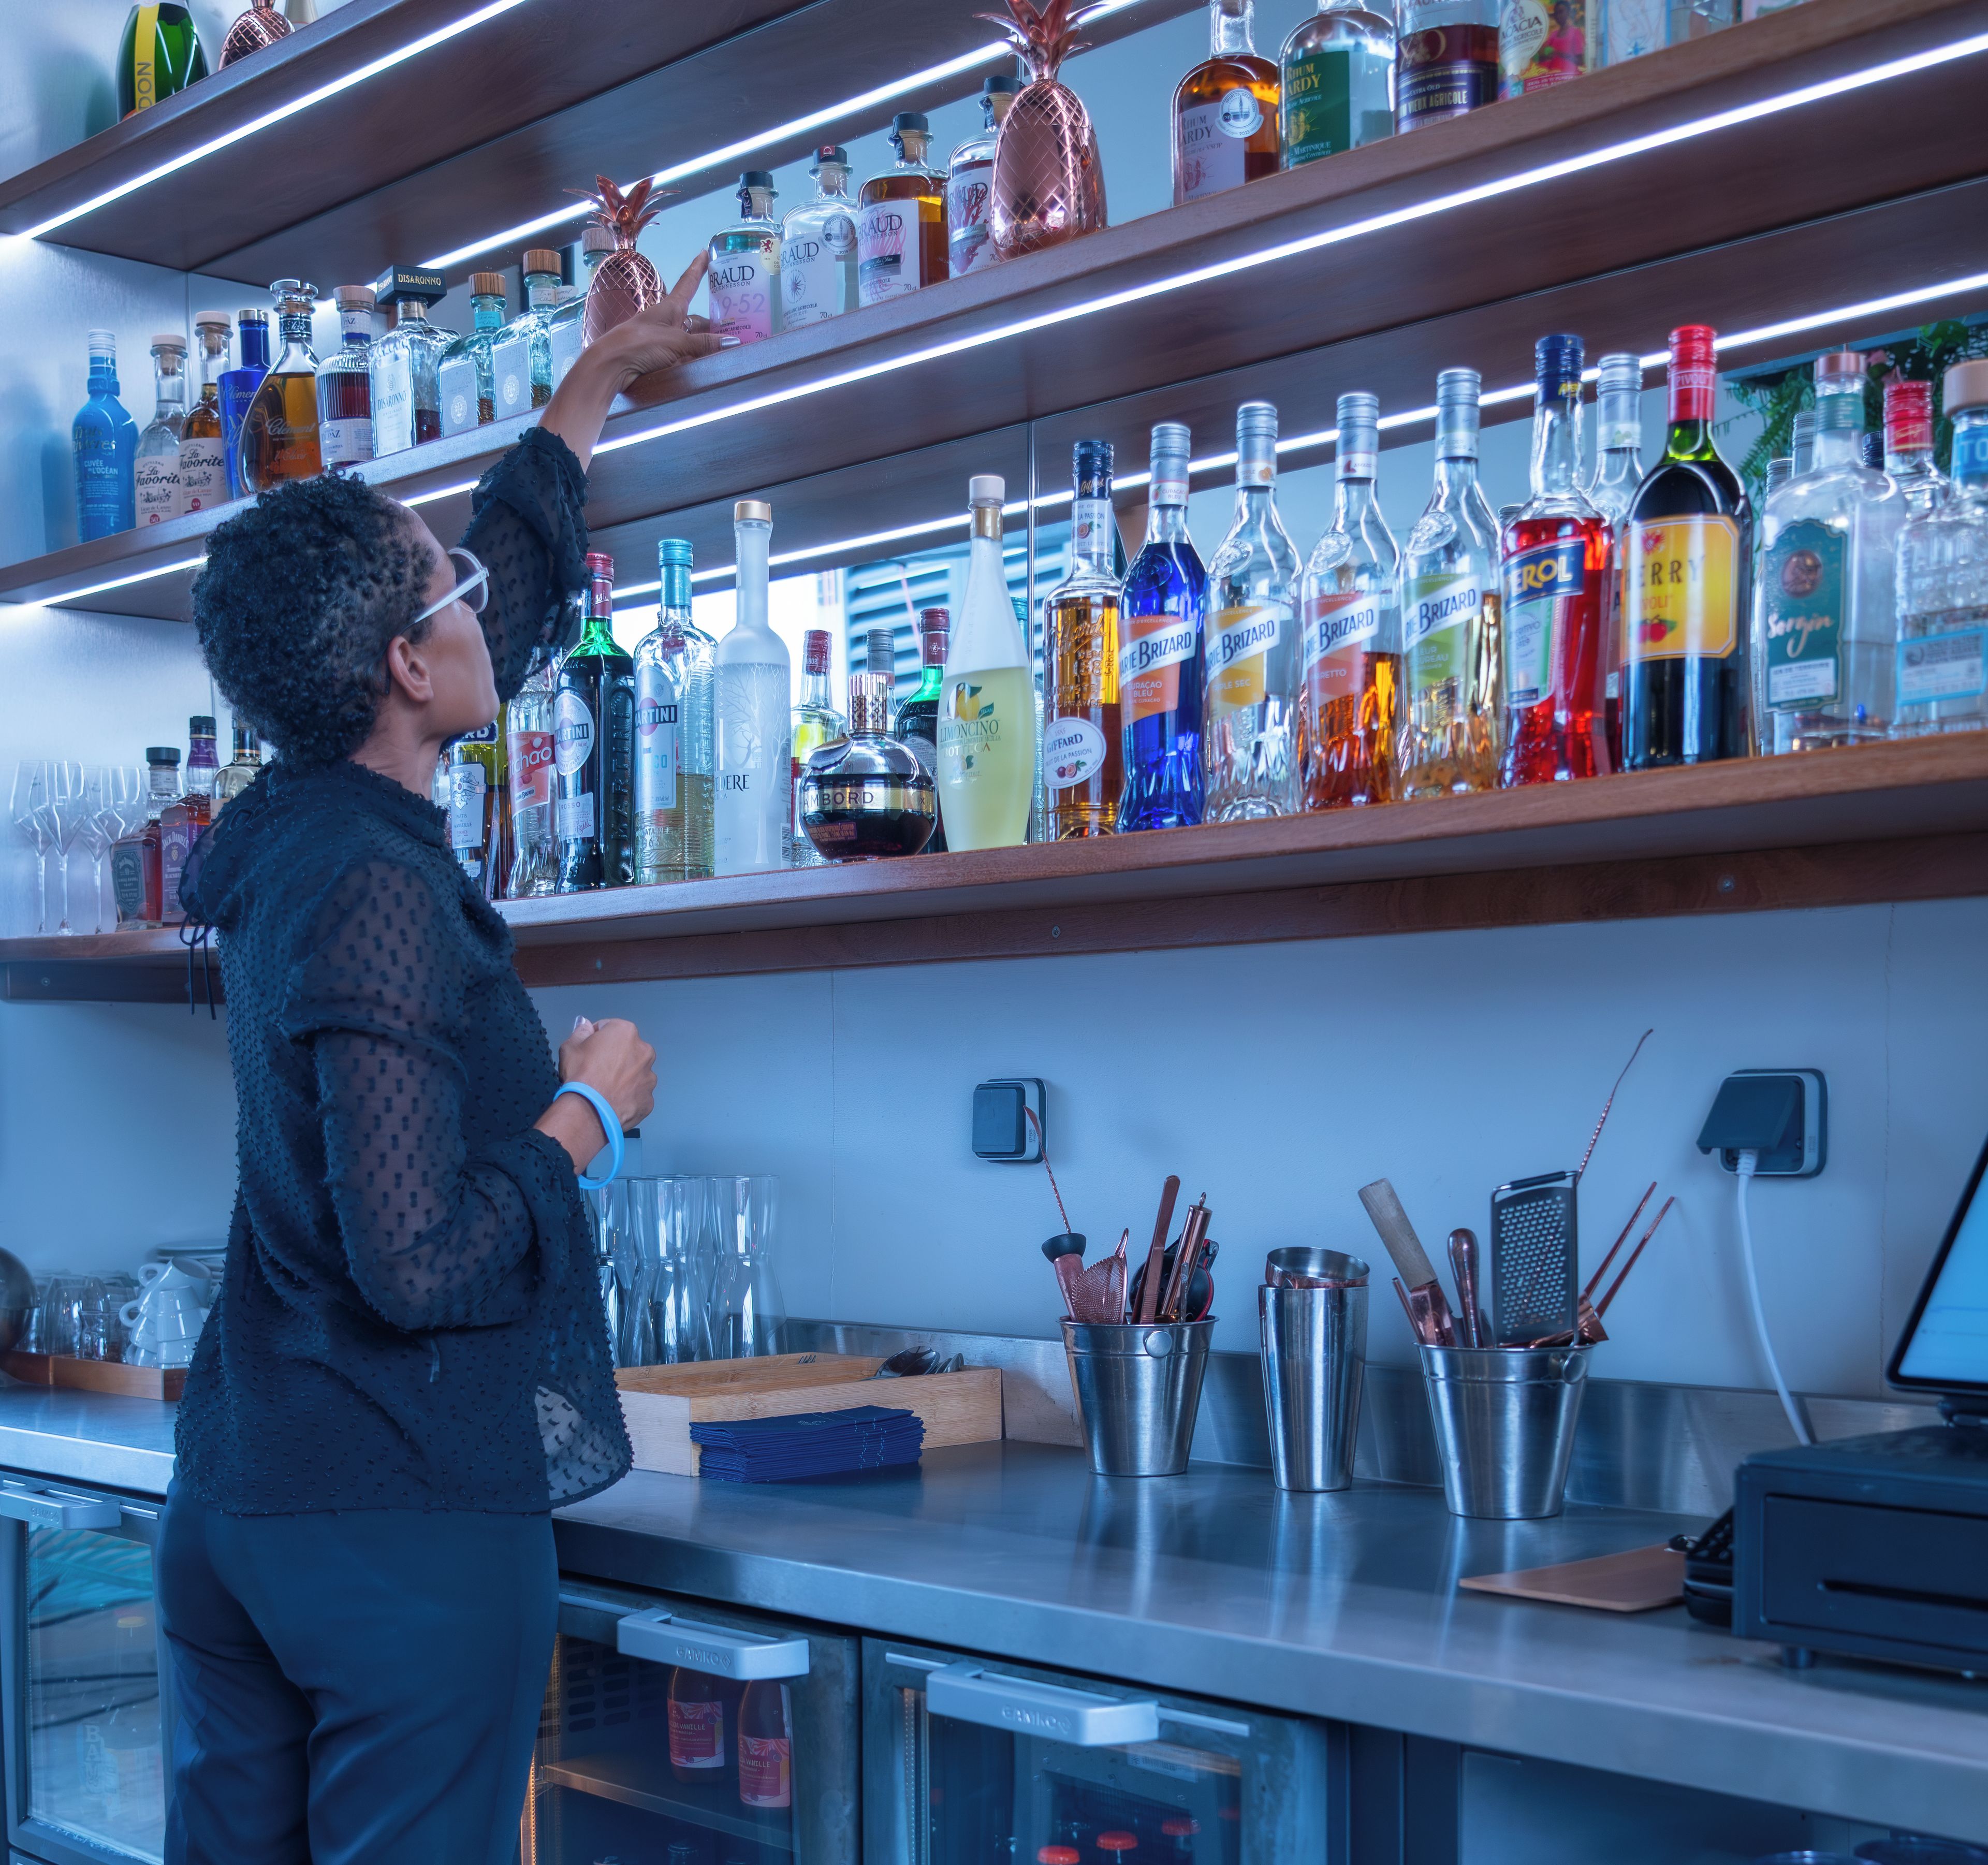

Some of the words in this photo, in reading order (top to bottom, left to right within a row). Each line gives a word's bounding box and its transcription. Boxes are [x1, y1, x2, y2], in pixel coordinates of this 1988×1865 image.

[1399, 29, 1447, 72] XO
[1287, 63, 1314, 81] RHUM
[1288, 74, 1322, 96] ARDY
[1225, 93, 1240, 104] SPIRITS
[1242, 92, 1255, 112] SELECTION
[1408, 96, 1427, 114] VIEUX
[1429, 90, 1468, 108] AGRICOLE
[1182, 124, 1215, 145] ARDY
[1294, 141, 1332, 155] MARTINIQUE
[858, 214, 903, 242] BRAUD
[781, 242, 819, 269] BRAUD
[783, 257, 815, 272] QUENNESSON
[398, 273, 442, 286] DISARONNO
[710, 265, 755, 290] BRAUD
[713, 281, 751, 294] QUENNESSON
[798, 303, 818, 311] AGRICOLE
[377, 390, 406, 411] DISARONNO
[84, 459, 104, 467] CUVÉE
[93, 467, 119, 475] L'OCÉAN
[180, 454, 225, 472] Favorite
[1420, 588, 1476, 634] BRIZARD
[1319, 608, 1375, 653] BRIZARD
[1139, 632, 1191, 669] BRIZARD
[1221, 619, 1275, 664] BRIZARD
[1073, 660, 1114, 678] 1885
[1127, 680, 1162, 691] CURAÇAO
[1235, 678, 1251, 689] SEC
[1133, 689, 1153, 698] BLEU
[940, 720, 999, 742] LIMONCINO
[1047, 733, 1083, 754] GIFFARD
[1068, 748, 1092, 759] PASSION
[715, 774, 750, 792] EDERE
[561, 802, 580, 810] ROSSO
[803, 791, 875, 809] AMBORD
[162, 835, 172, 851] JACK
[172, 831, 189, 849] DANIEL'S
[746, 1759, 770, 1768] VANILLE
